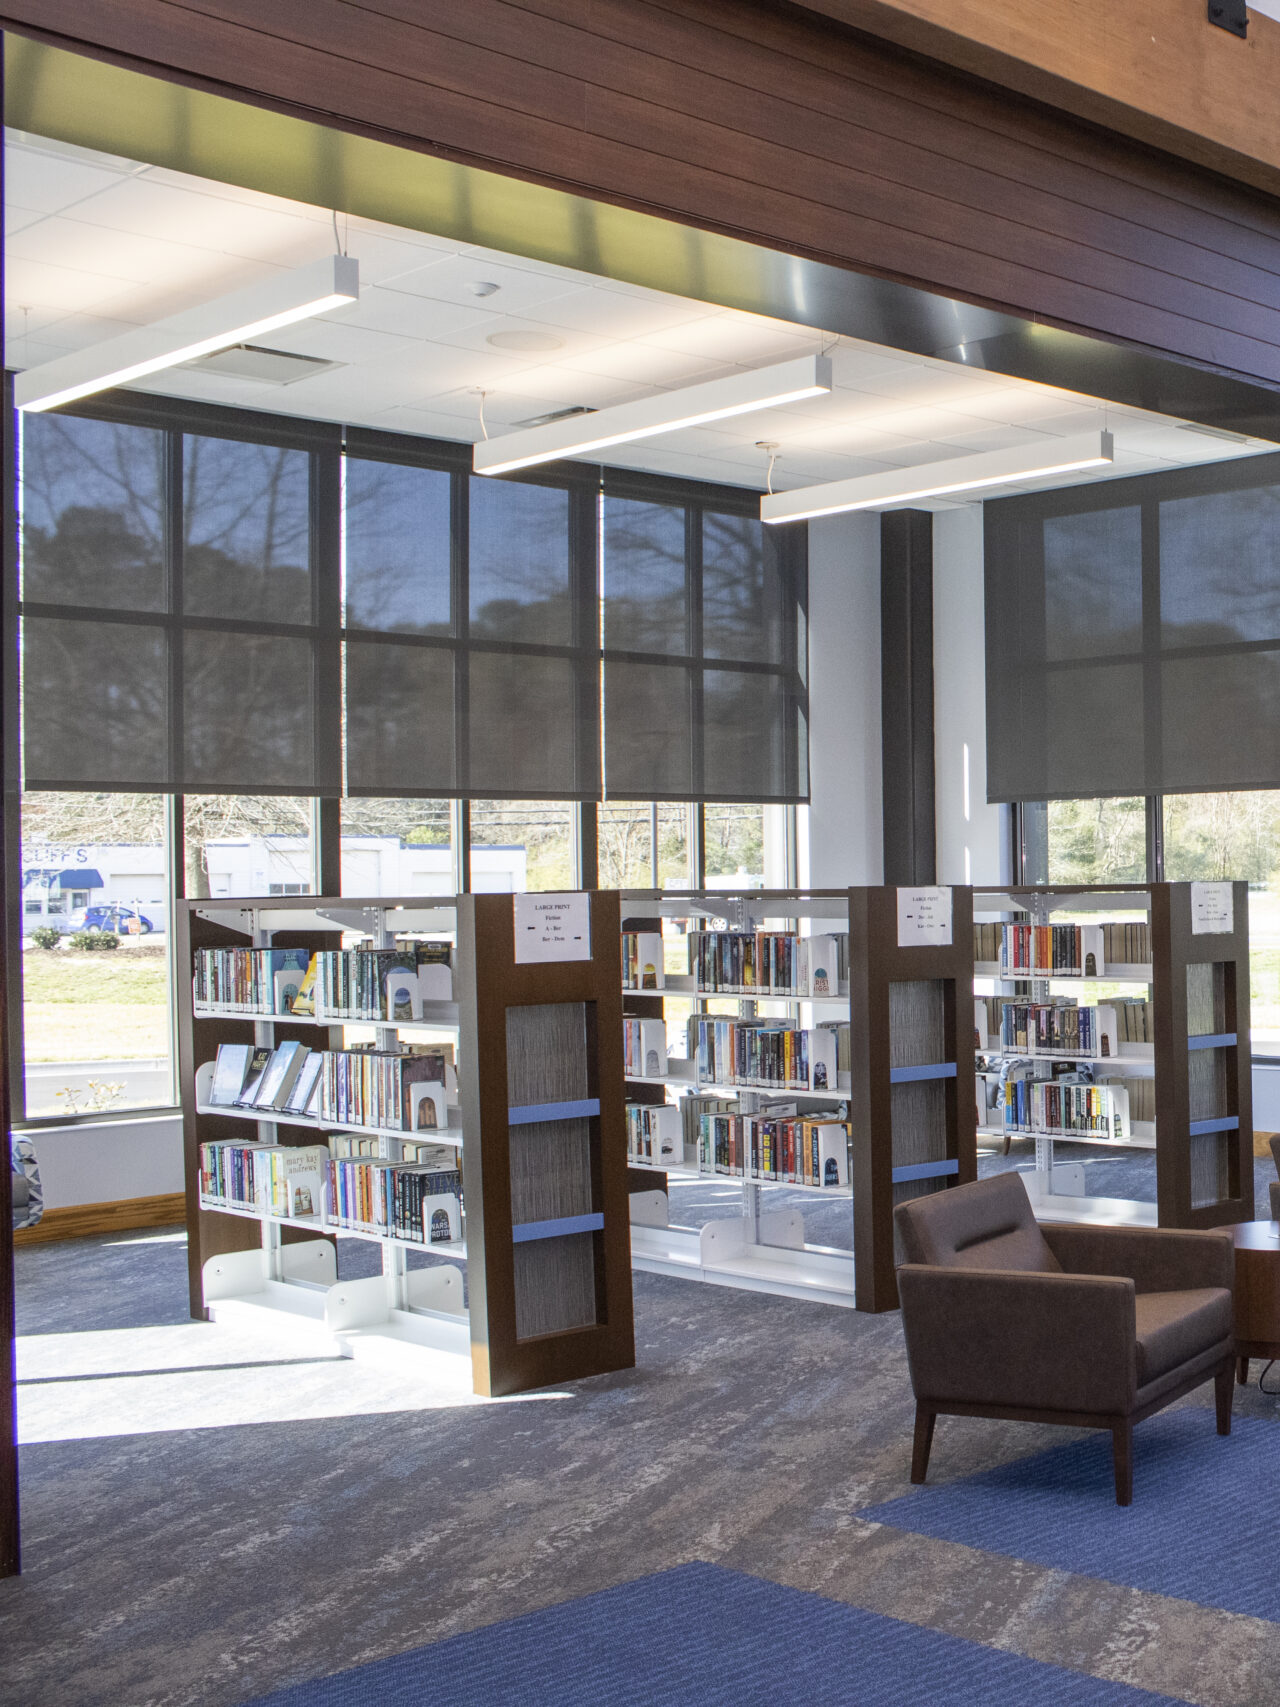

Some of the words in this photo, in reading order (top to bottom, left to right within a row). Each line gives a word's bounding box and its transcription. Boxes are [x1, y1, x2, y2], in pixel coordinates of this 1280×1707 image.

[286, 1157, 304, 1166] mary
[306, 1153, 319, 1164] kay
[288, 1164, 317, 1174] andrews
